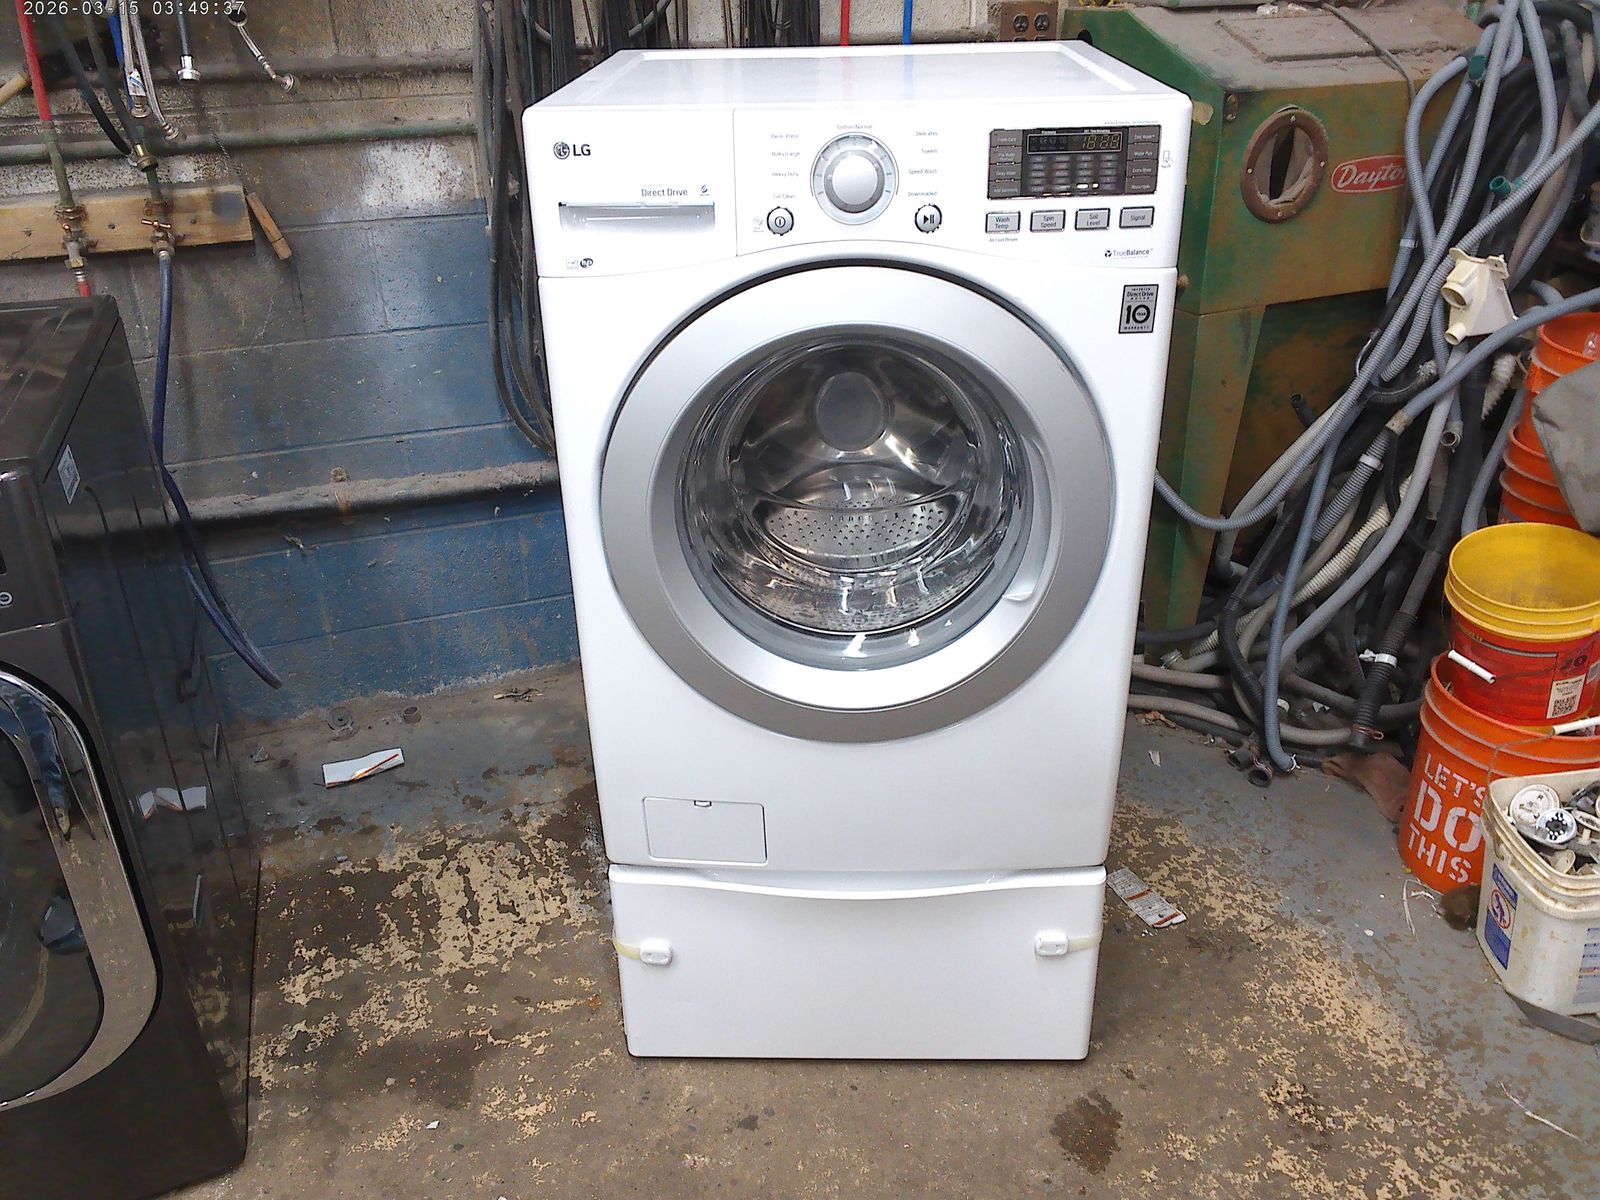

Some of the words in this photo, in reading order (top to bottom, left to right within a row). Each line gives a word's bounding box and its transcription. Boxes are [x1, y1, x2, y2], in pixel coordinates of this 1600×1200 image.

[572, 144, 591, 156] LG
[641, 188, 665, 196] Direct
[667, 188, 688, 196] Drive
[1126, 304, 1151, 324] 10
[1414, 779, 1482, 853] DO
[1408, 822, 1472, 883] THIS
